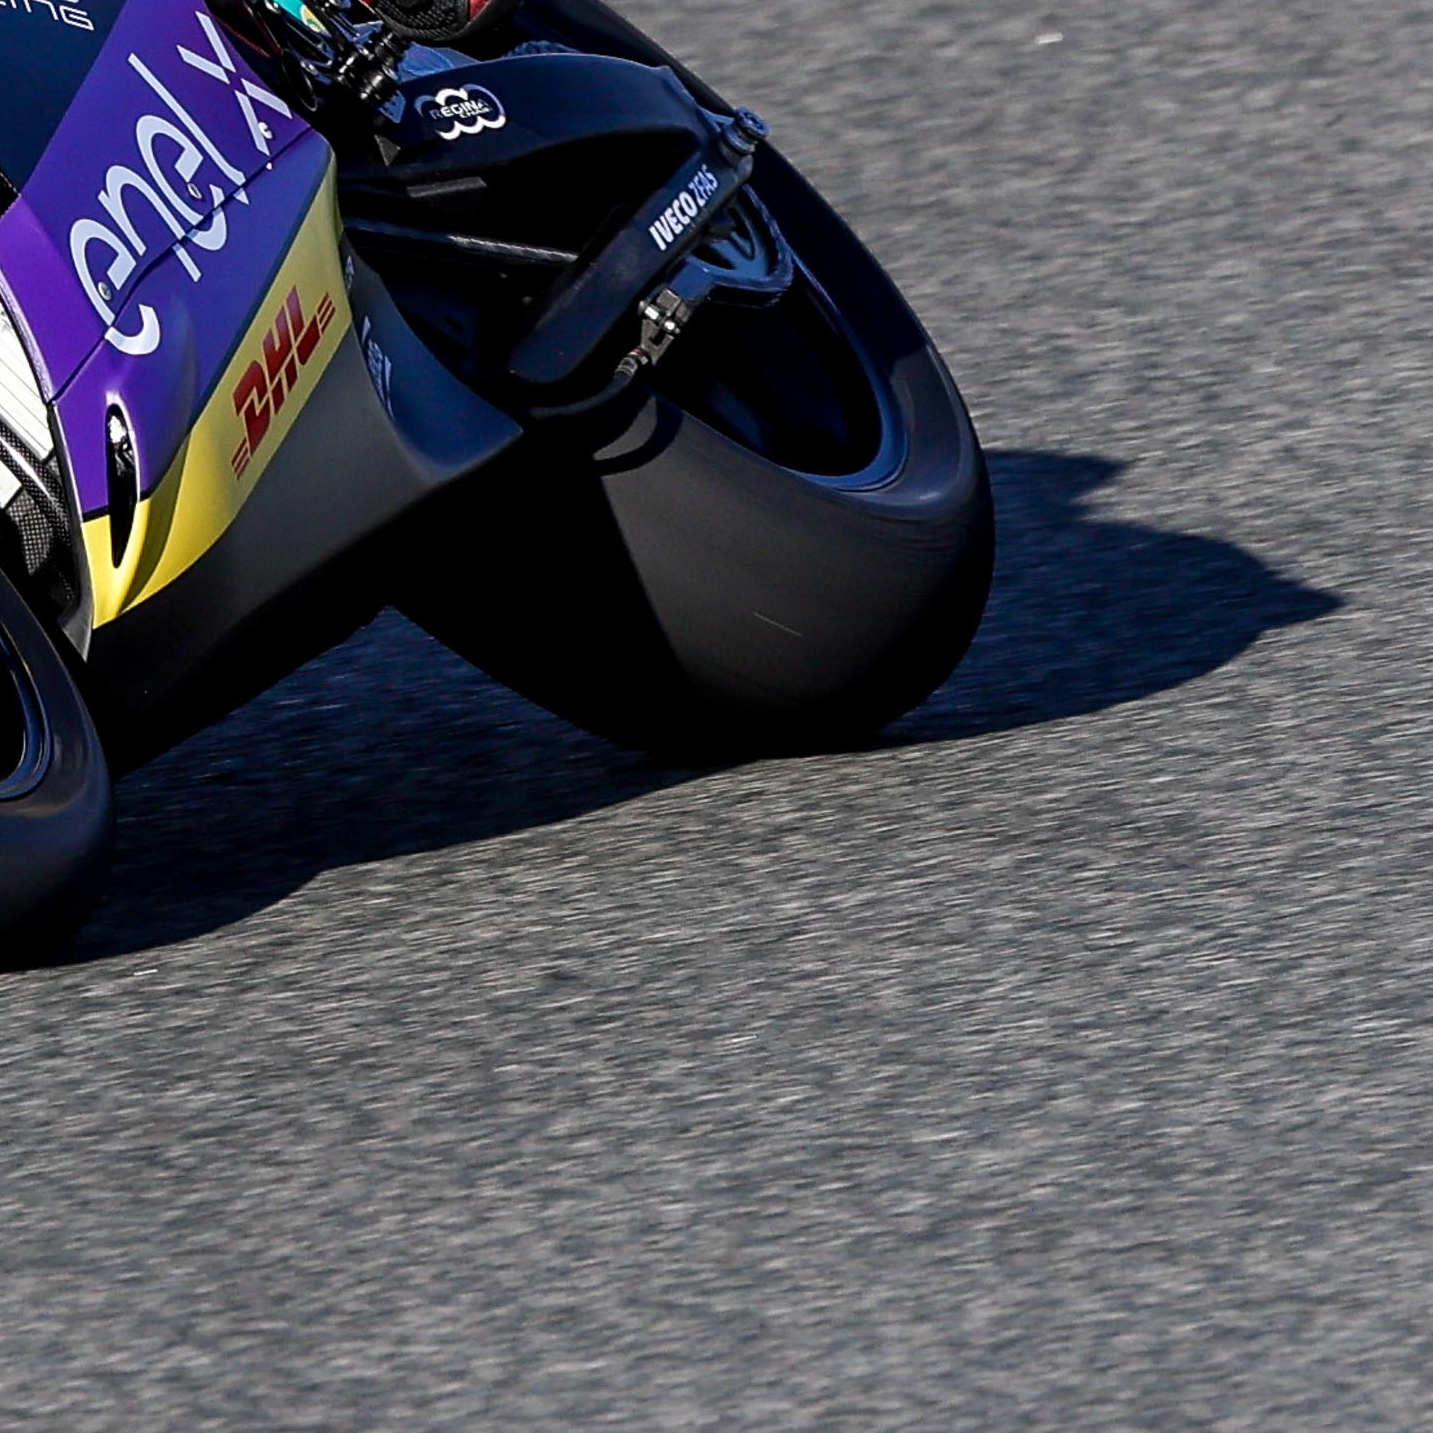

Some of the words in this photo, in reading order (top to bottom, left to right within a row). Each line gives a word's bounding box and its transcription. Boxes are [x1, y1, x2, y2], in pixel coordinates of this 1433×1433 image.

[70, 51, 250, 356] enel
[648, 191, 698, 251] IVECO
[232, 285, 321, 458] DHL
